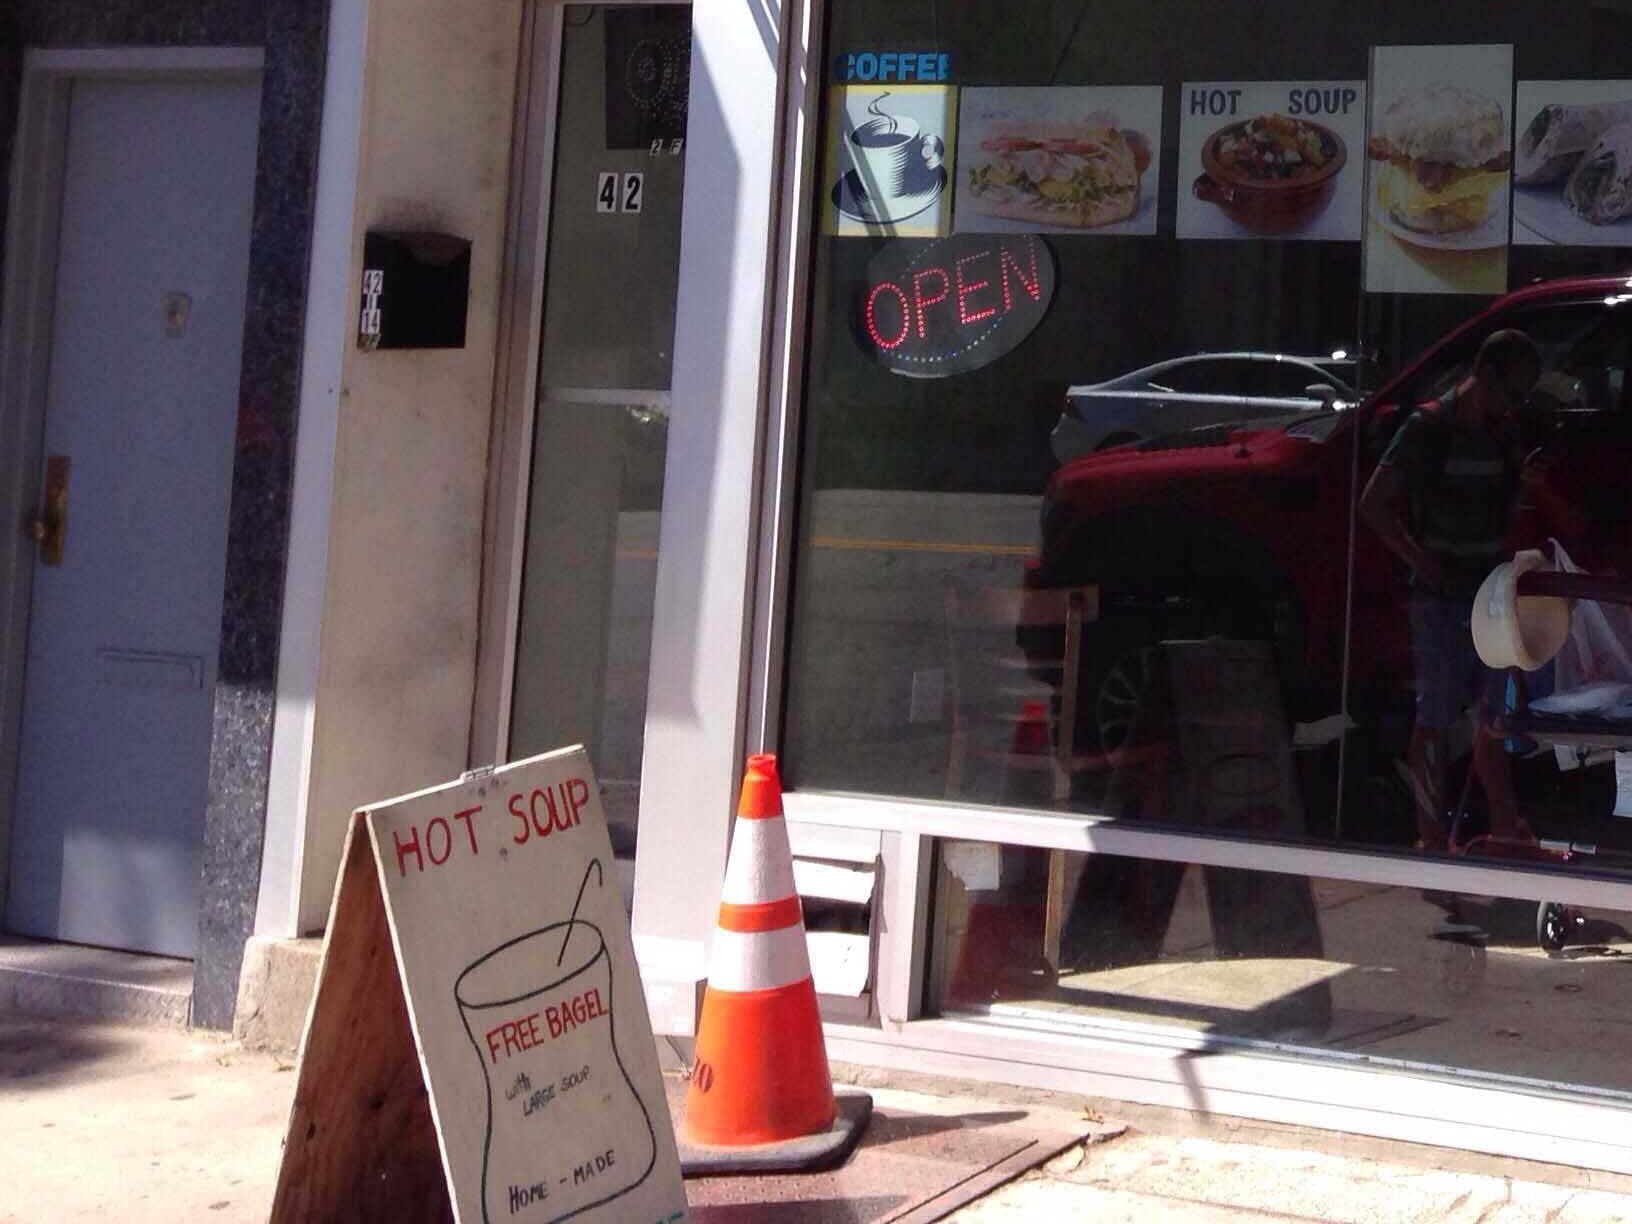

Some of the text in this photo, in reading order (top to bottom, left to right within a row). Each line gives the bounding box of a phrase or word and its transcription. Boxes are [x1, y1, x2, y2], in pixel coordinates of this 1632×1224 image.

[1190, 88, 1357, 116] HOT SOUP
[600, 175, 641, 209] 42
[865, 245, 1040, 349] OPEN
[393, 776, 590, 879] HOT SOUP
[486, 988, 608, 1065] FREE BAGEL
[523, 1064, 593, 1117] LARGE SOUP
[508, 1181, 549, 1215] HOME
[573, 1149, 616, 1186] MADE
